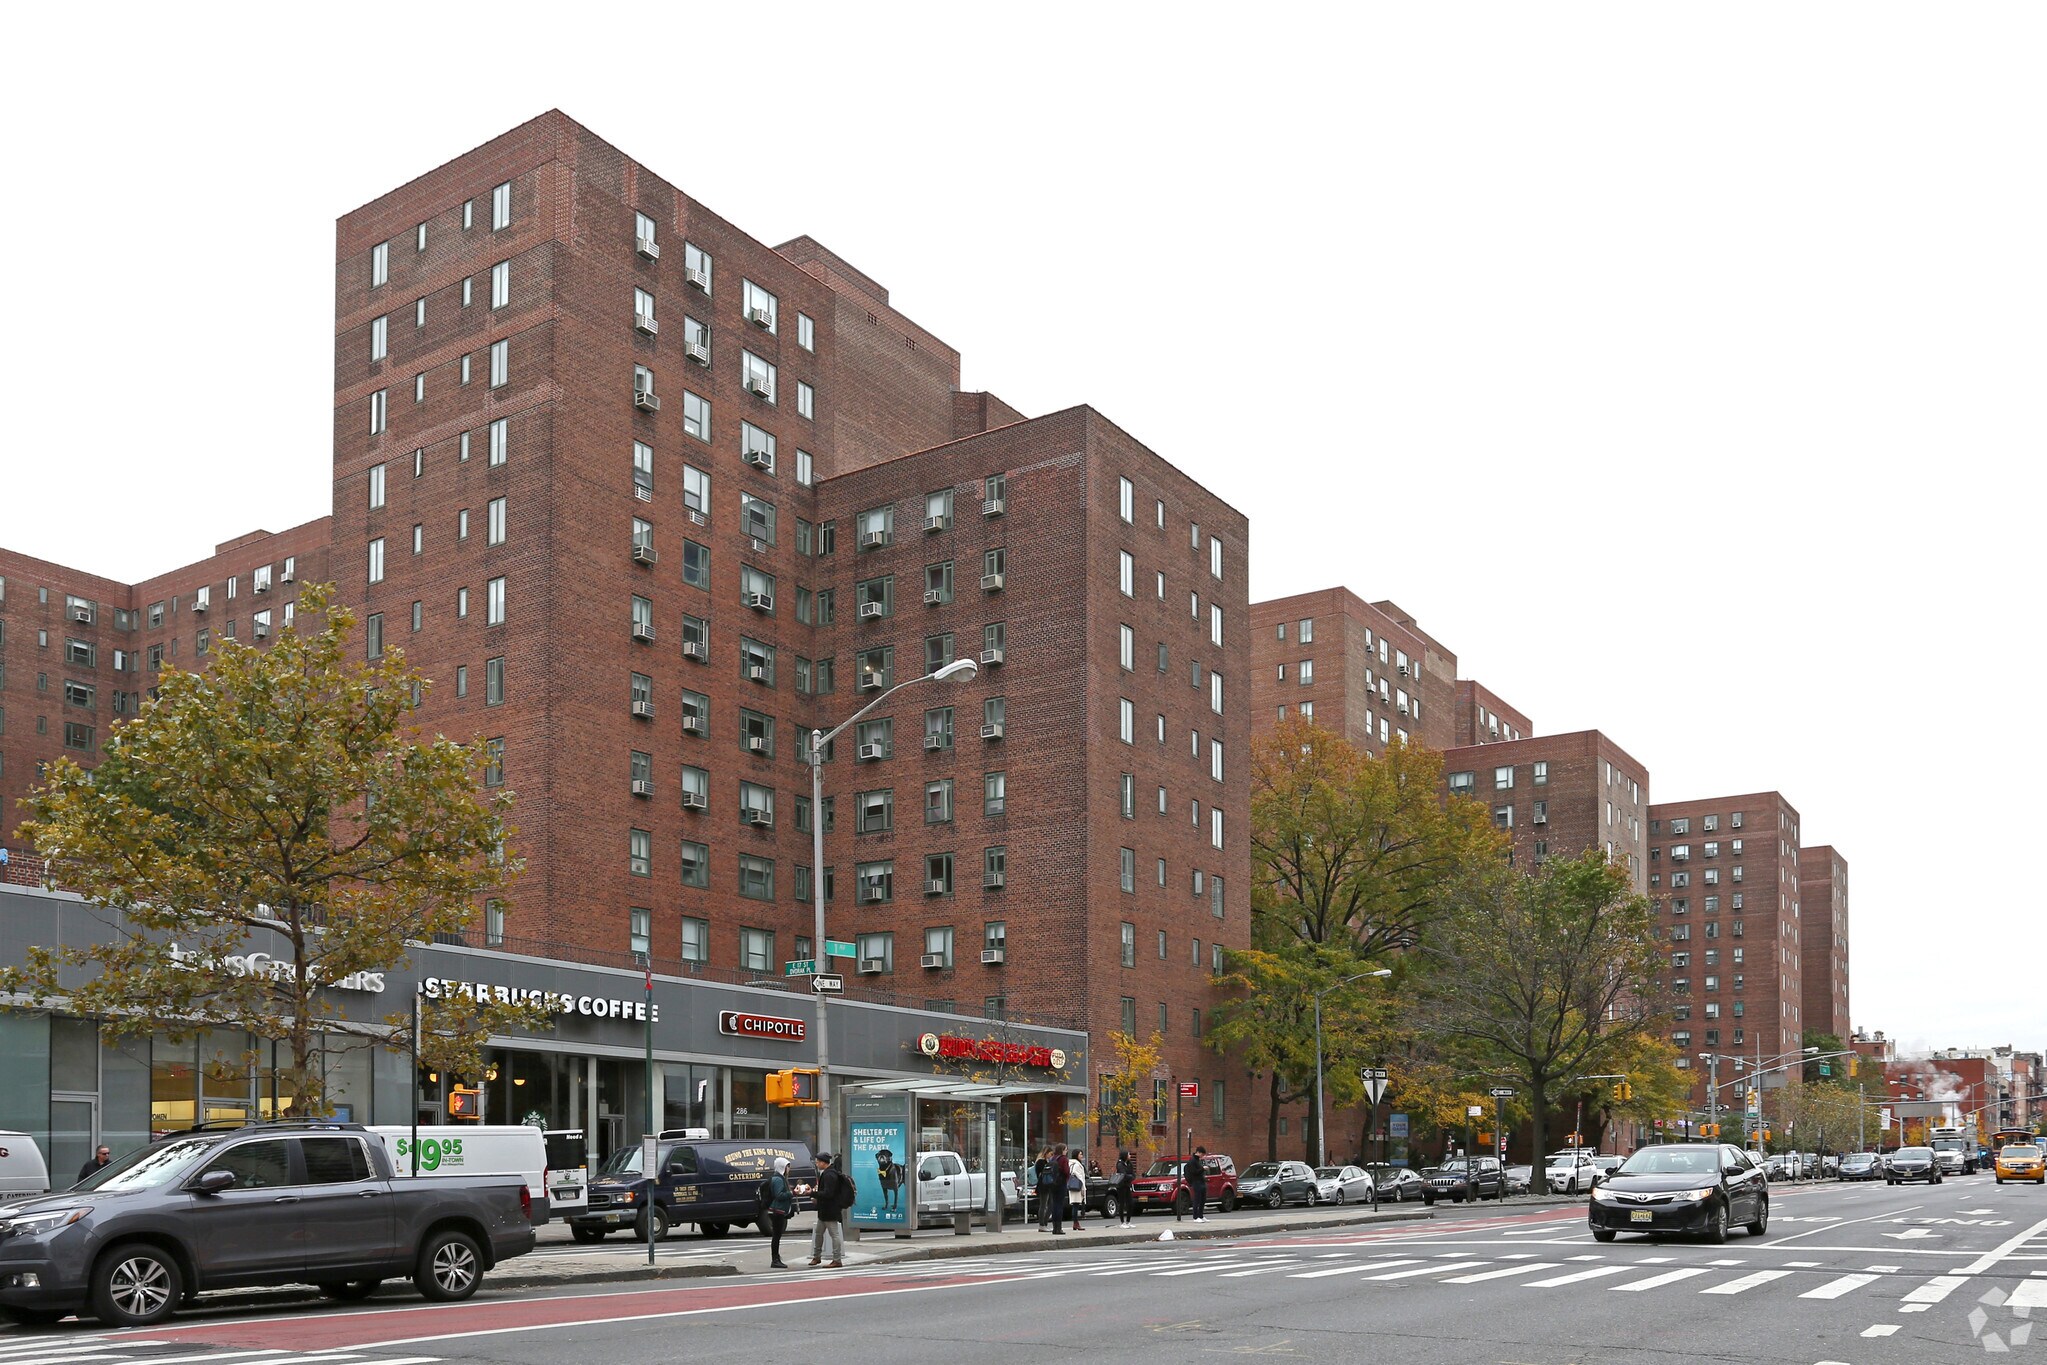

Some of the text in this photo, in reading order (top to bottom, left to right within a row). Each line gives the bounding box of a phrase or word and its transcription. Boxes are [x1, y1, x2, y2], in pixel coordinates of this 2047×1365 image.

[425, 977, 658, 1022] STARBUCKS COFFEE
[744, 1018, 804, 1036] CHIPOTLE
[724, 1150, 742, 1164] BRUNO
[742, 1148, 752, 1158] THE
[729, 1172, 760, 1180] CATERING
[1872, 1218, 2014, 1226] ONLY
